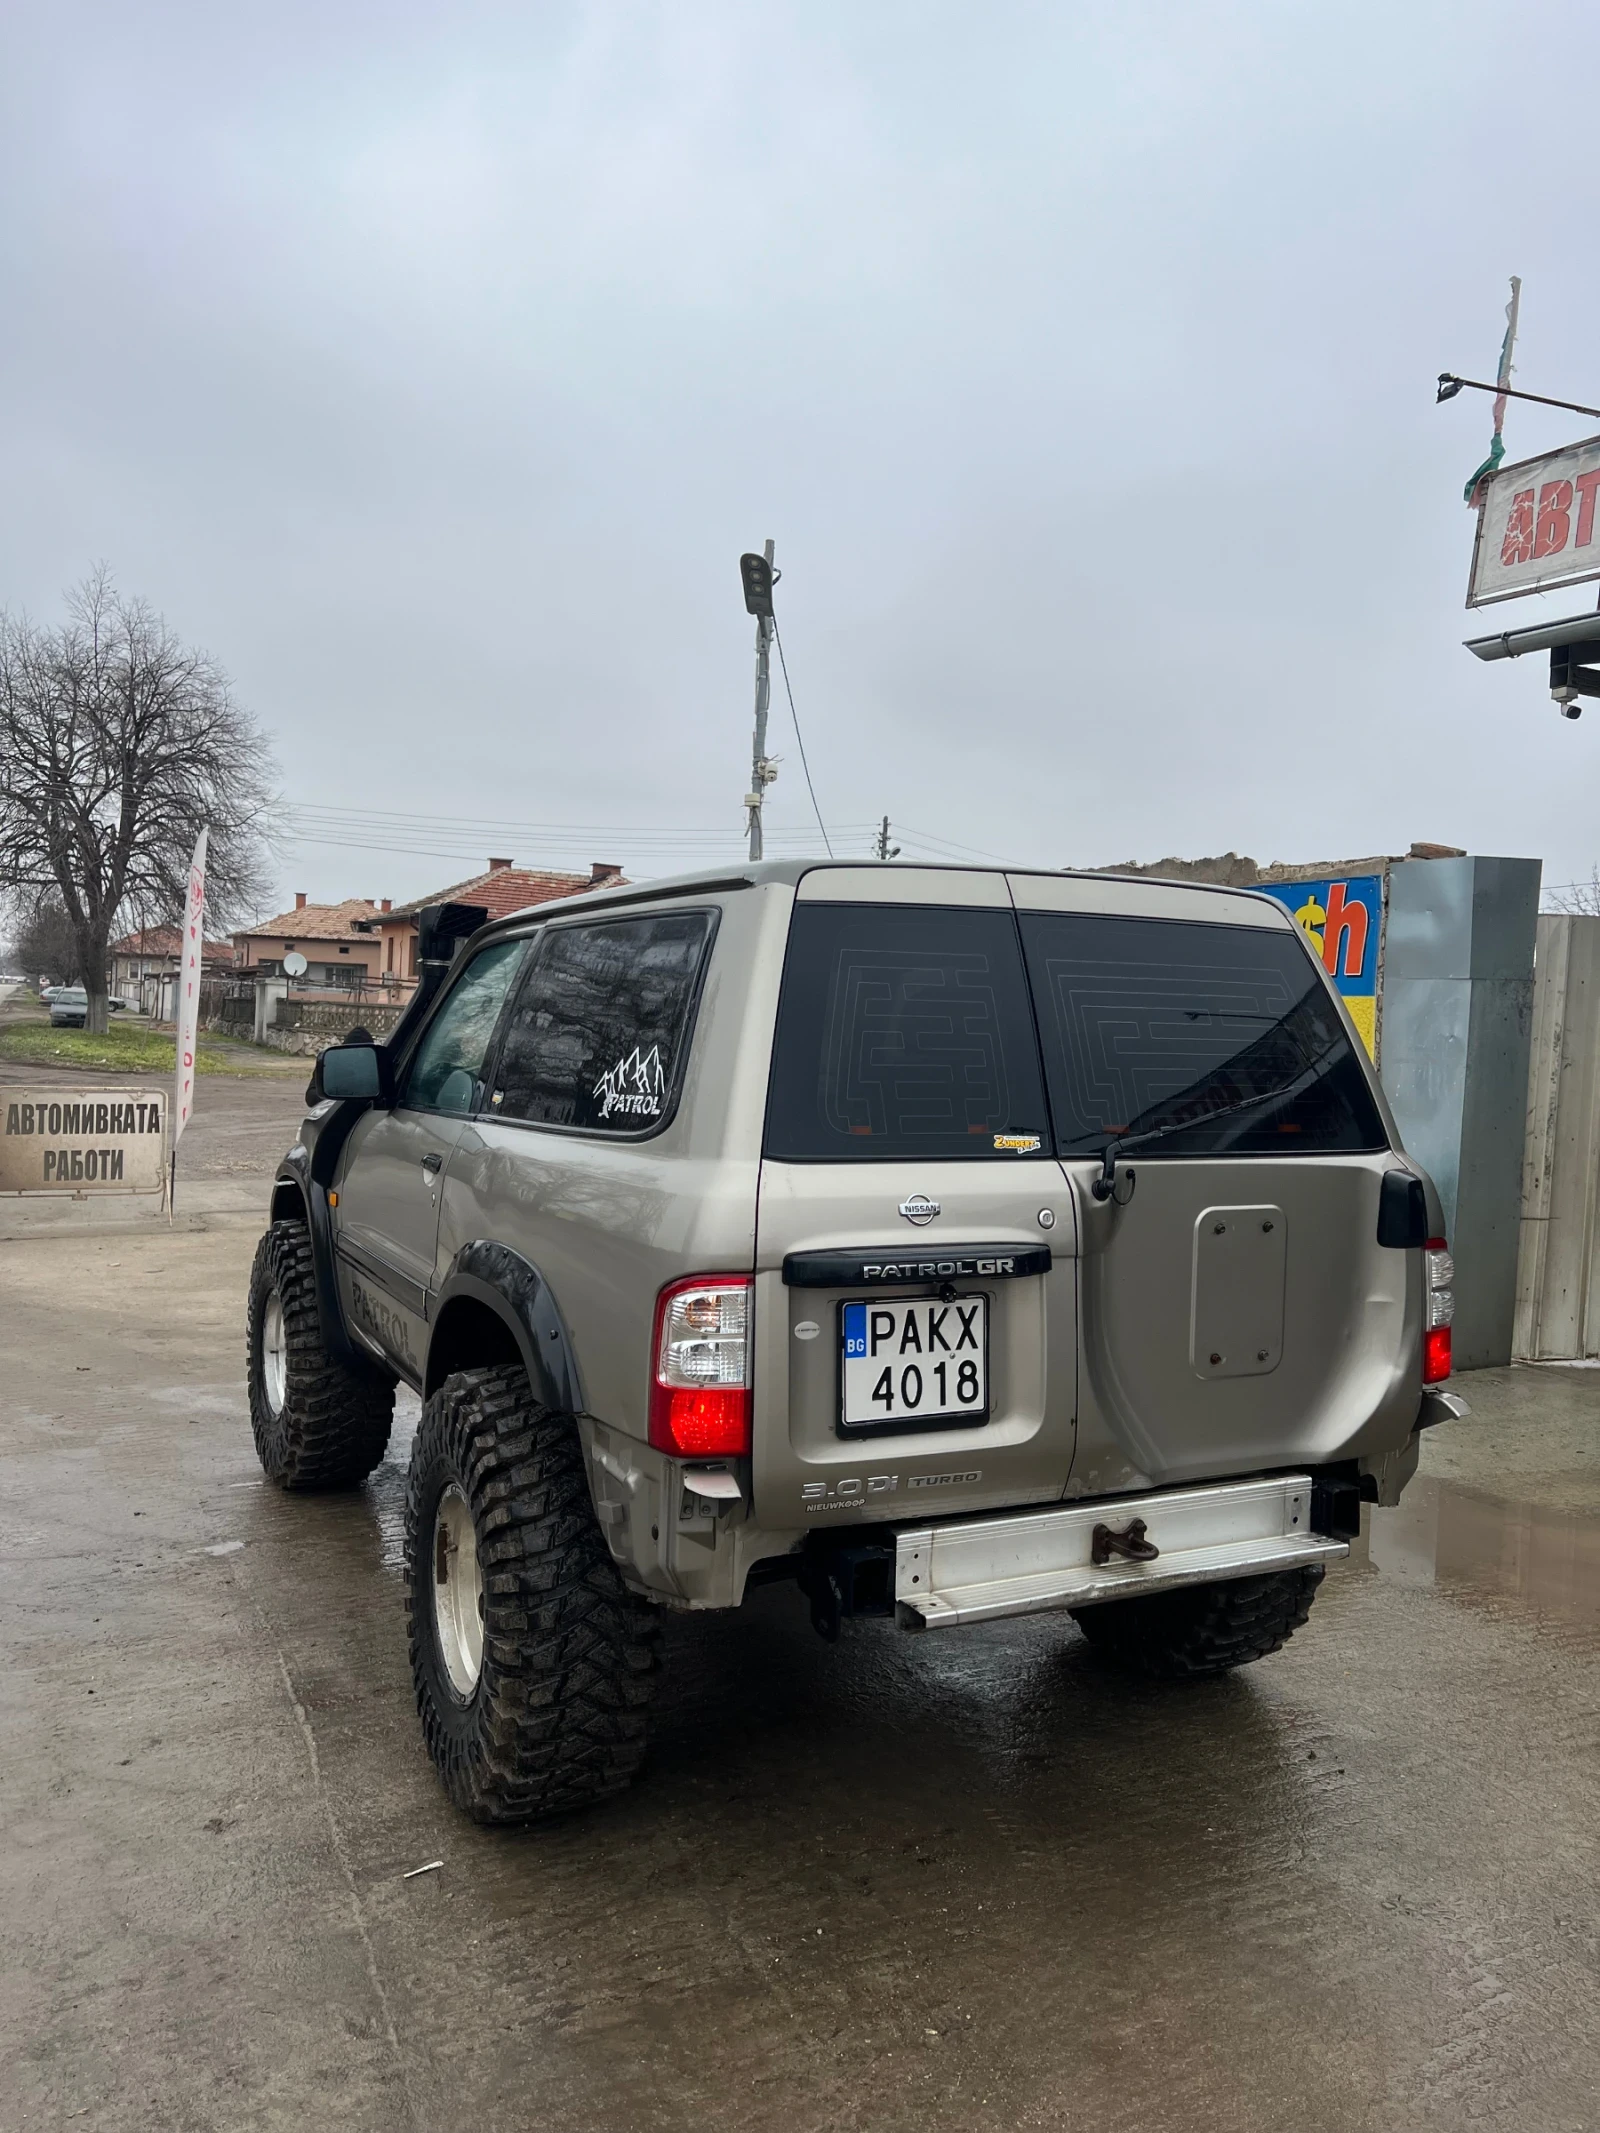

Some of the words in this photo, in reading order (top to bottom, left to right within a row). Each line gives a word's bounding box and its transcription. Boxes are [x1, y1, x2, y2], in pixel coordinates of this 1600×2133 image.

[607, 1094, 661, 1115] PATROL
[6, 1103, 160, 1135] АВТОМИВКАТА
[43, 1150, 124, 1181] РАБОТИ
[904, 1205, 937, 1213] NISSAN
[863, 1261, 973, 1279] PATROL
[977, 1258, 1015, 1275] GR
[352, 1279, 417, 1366] PATROL
[871, 1305, 979, 1357] PAKX
[847, 1338, 865, 1353] BG
[872, 1359, 979, 1411] 4018
[913, 1473, 978, 1487] TURBO
[806, 1499, 866, 1512] NIEUWKOOP
